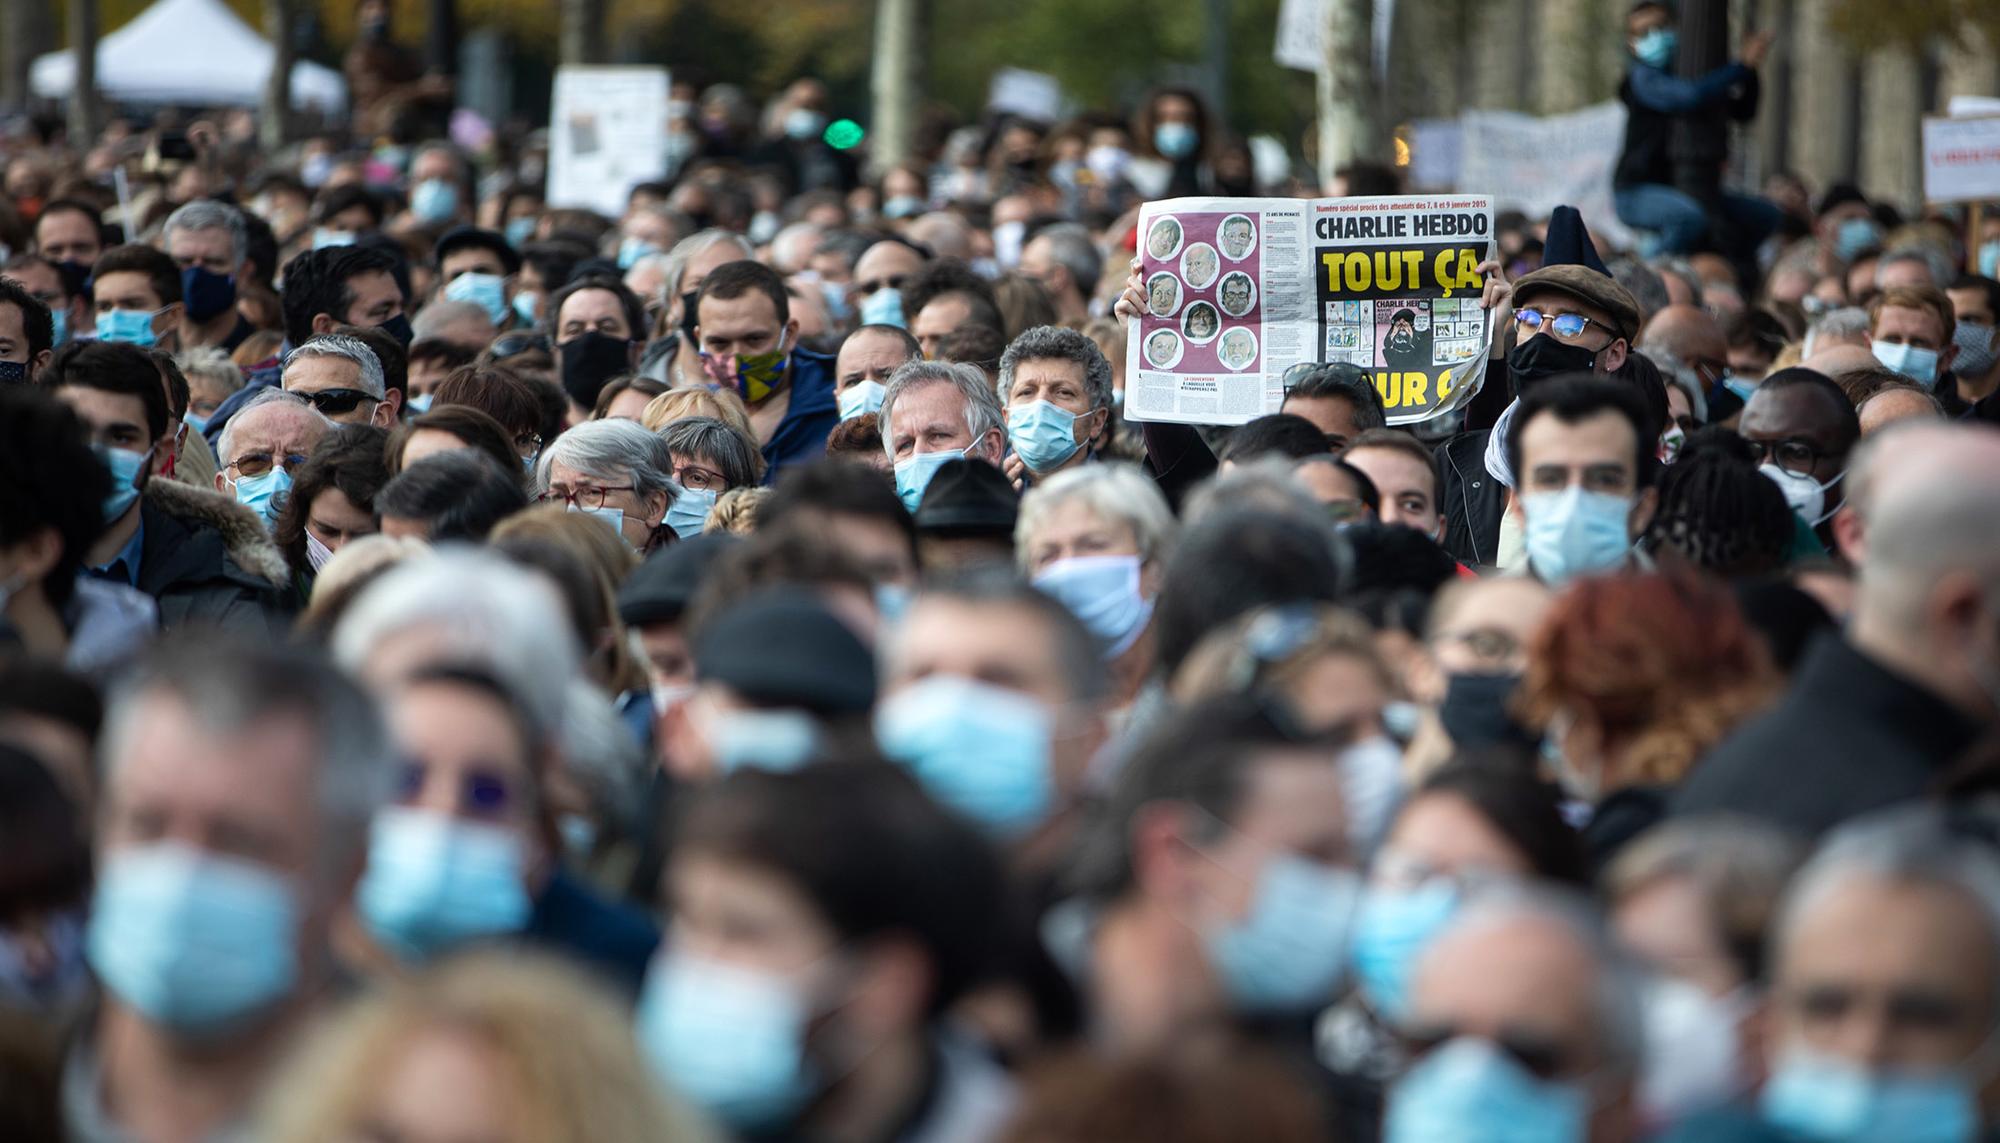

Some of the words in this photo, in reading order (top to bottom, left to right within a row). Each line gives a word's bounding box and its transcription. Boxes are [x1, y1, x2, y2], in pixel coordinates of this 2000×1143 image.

[1340, 204, 1358, 212] spécial
[1360, 203, 1378, 211] procès
[1451, 201, 1471, 209] janvier
[1472, 200, 1487, 208] 2015
[1315, 215, 1406, 239] CHARLIE
[1413, 213, 1488, 236] HEBDO
[1322, 251, 1424, 292] TOUT
[1434, 249, 1483, 298] ÇA
